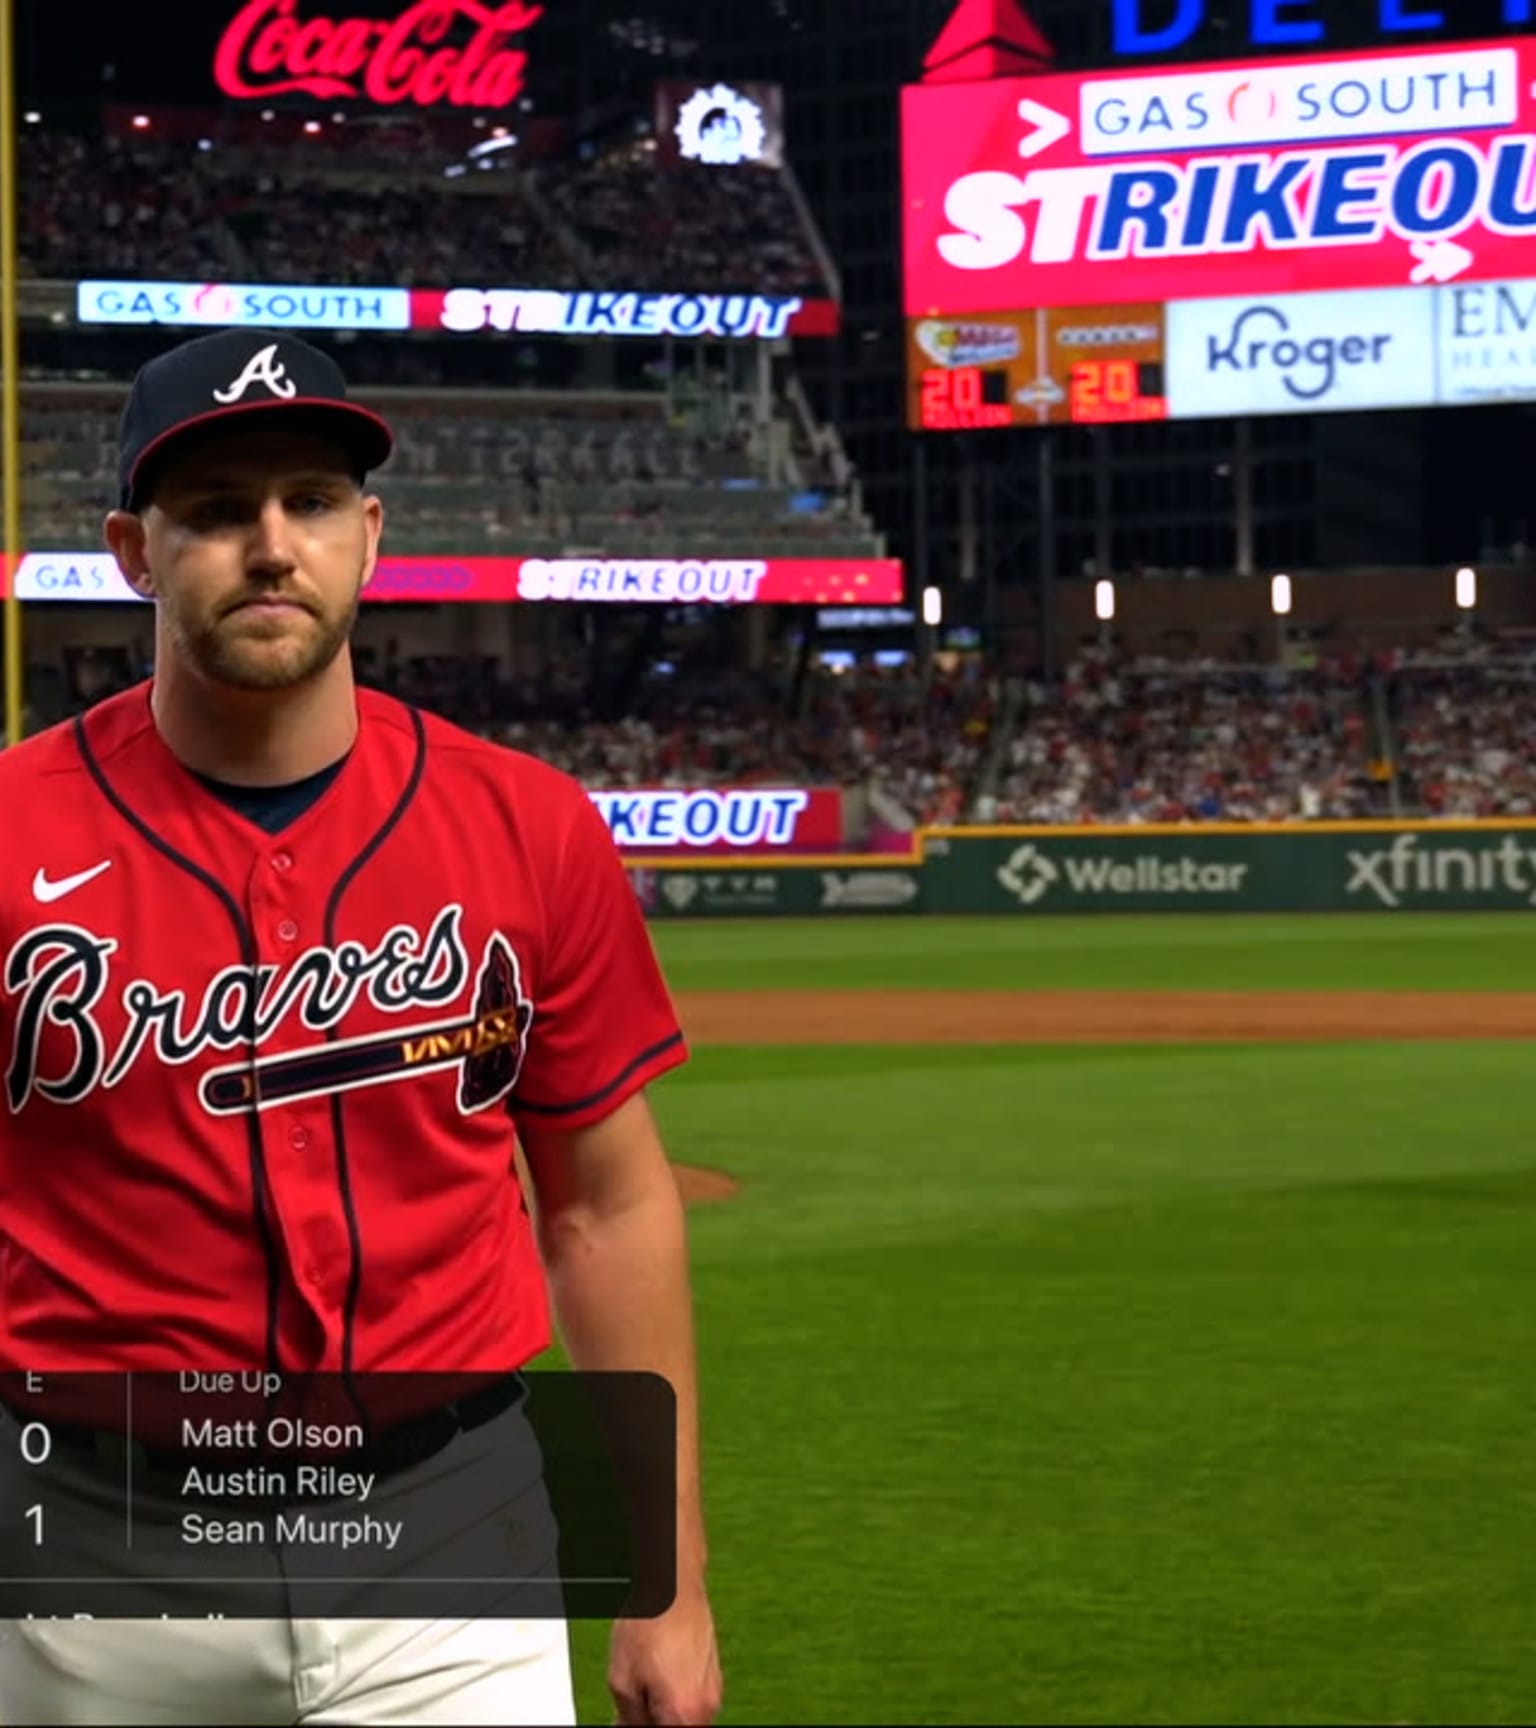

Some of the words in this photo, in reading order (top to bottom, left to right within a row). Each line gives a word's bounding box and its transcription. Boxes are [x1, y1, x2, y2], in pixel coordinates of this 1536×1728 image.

[213, 0, 544, 108] Coca-Cola
[1094, 92, 1209, 136] GAS
[1297, 69, 1496, 122] SOUTH
[96, 290, 182, 316] GAS
[244, 294, 383, 320] SOUTH
[212, 343, 297, 403] A
[1071, 359, 1137, 404] 20
[1207, 305, 1391, 400] Kroger
[35, 565, 105, 590] GAS
[1064, 856, 1248, 893] Wellstar
[4, 903, 469, 1115] Braves
